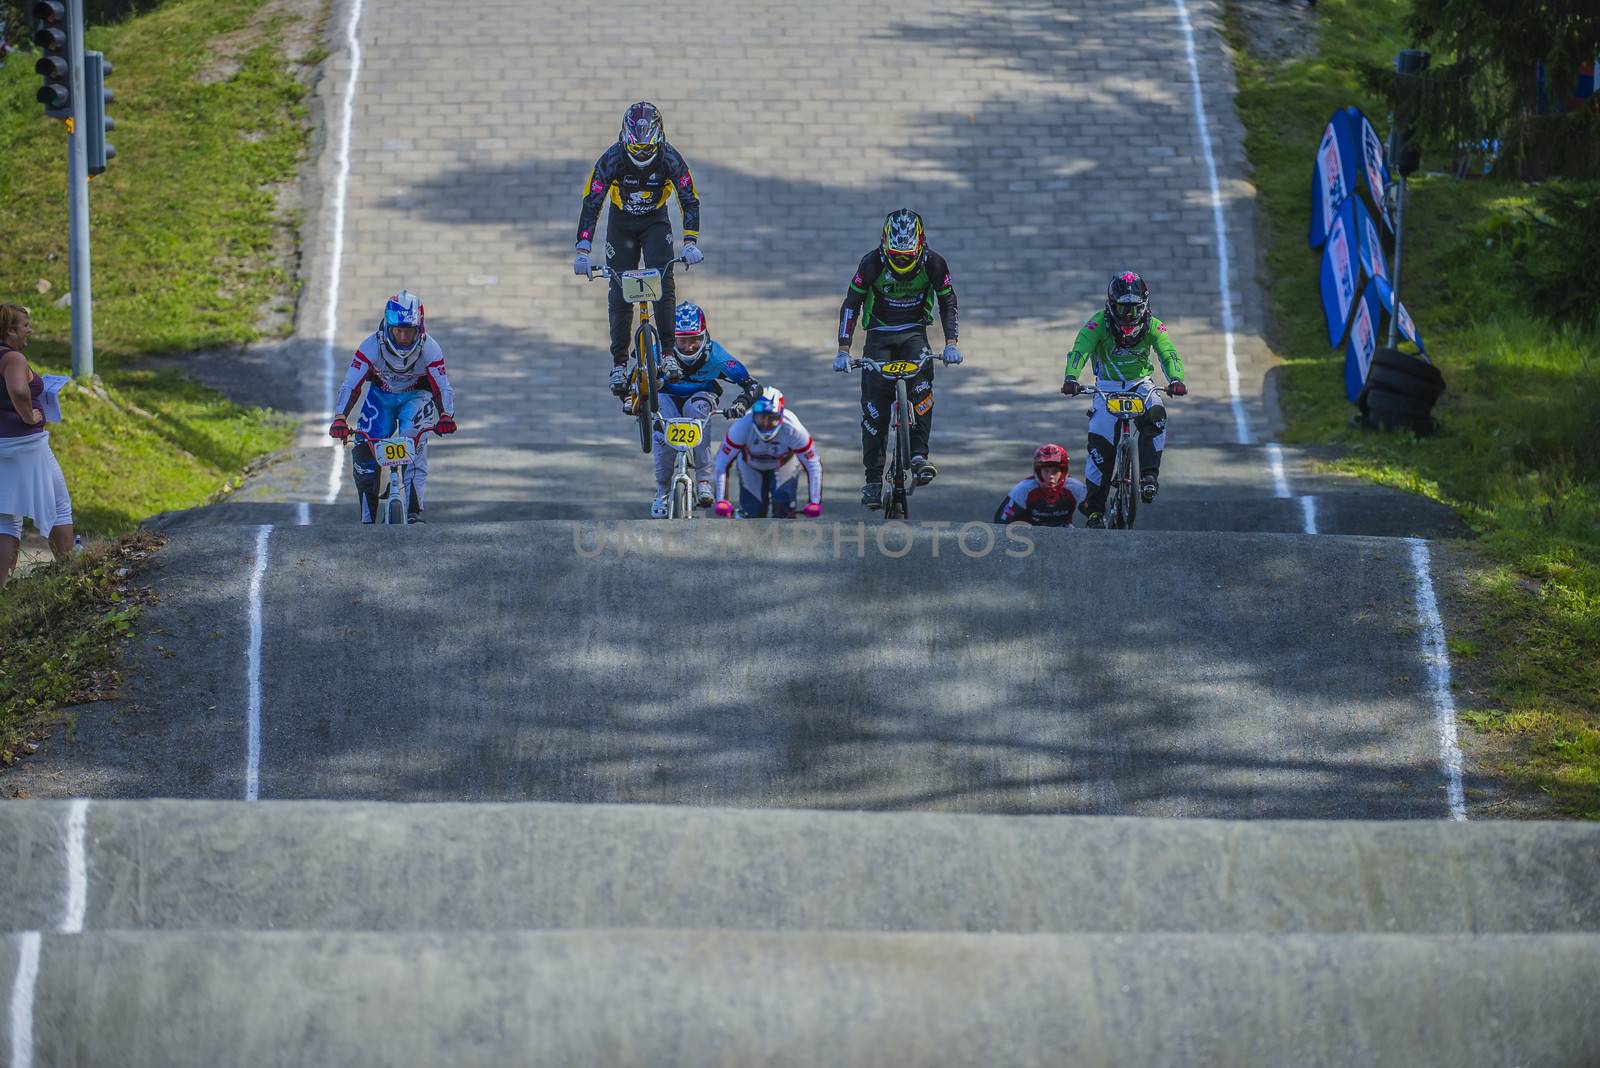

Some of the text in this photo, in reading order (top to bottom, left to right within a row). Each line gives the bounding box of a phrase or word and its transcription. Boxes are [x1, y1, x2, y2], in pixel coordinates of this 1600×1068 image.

[636, 279, 644, 292] 1
[889, 363, 907, 372] 68
[1119, 399, 1133, 411] 10
[671, 428, 695, 443] 229
[385, 444, 406, 460] 90
